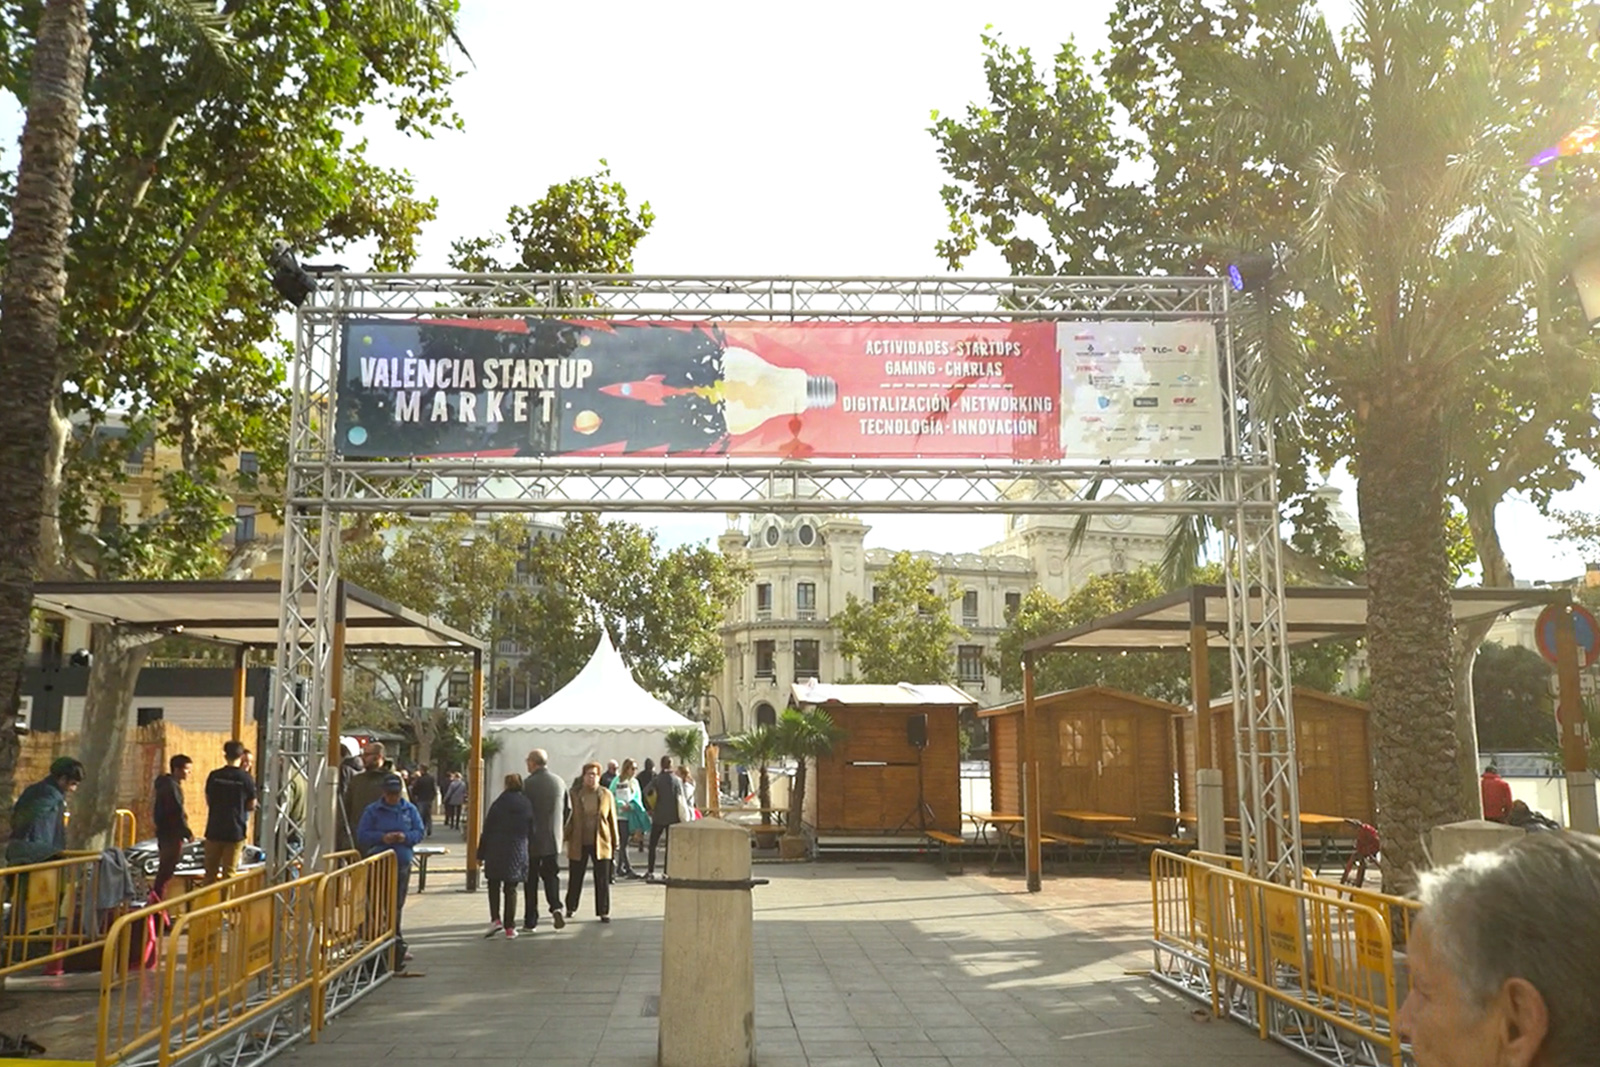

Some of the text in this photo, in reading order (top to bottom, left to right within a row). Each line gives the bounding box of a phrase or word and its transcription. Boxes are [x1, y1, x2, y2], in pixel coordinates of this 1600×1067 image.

[866, 340, 1021, 357] ACTIVIDADES STARTUPS
[360, 350, 593, 389] VALÈNCIA STARTUP
[885, 361, 1002, 377] GAMING CHARLAS
[395, 391, 555, 422] MARKET
[842, 393, 1052, 412] DIGITALIZACIÓN NETWORKING
[859, 416, 1037, 435] TECNOLOGÍA INNOVACIÓN
